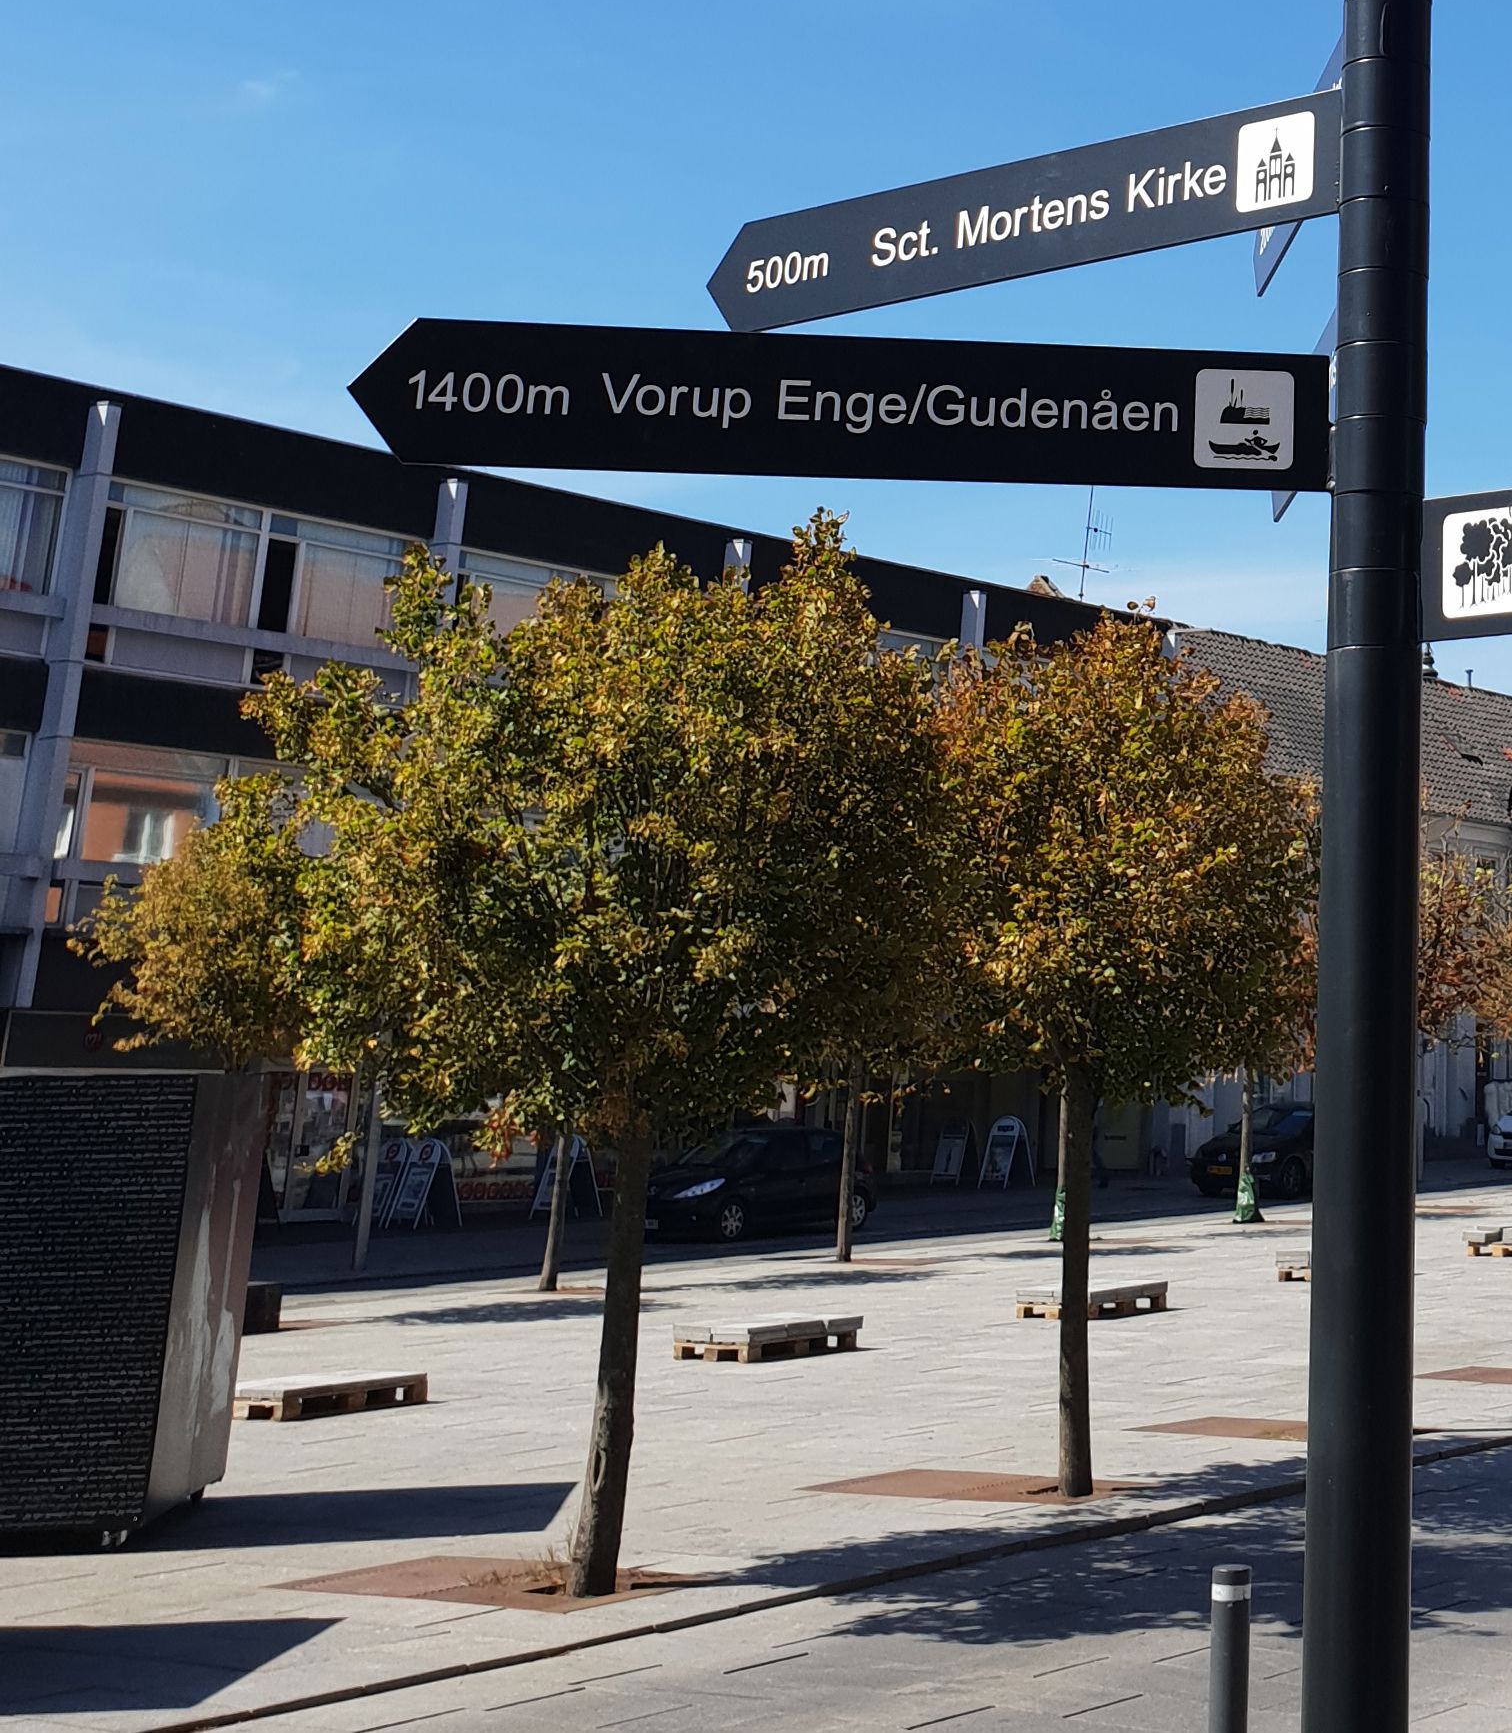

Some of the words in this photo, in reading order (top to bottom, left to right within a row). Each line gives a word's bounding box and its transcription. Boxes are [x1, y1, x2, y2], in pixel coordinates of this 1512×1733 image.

[746, 251, 829, 294] 500m
[871, 220, 939, 268] Sct.
[956, 189, 1110, 249] Mortens
[1127, 161, 1227, 213] Kirke
[408, 369, 570, 416] 1400m
[601, 372, 752, 429] Vorup
[777, 379, 1179, 434] Enge/Gudenåen
